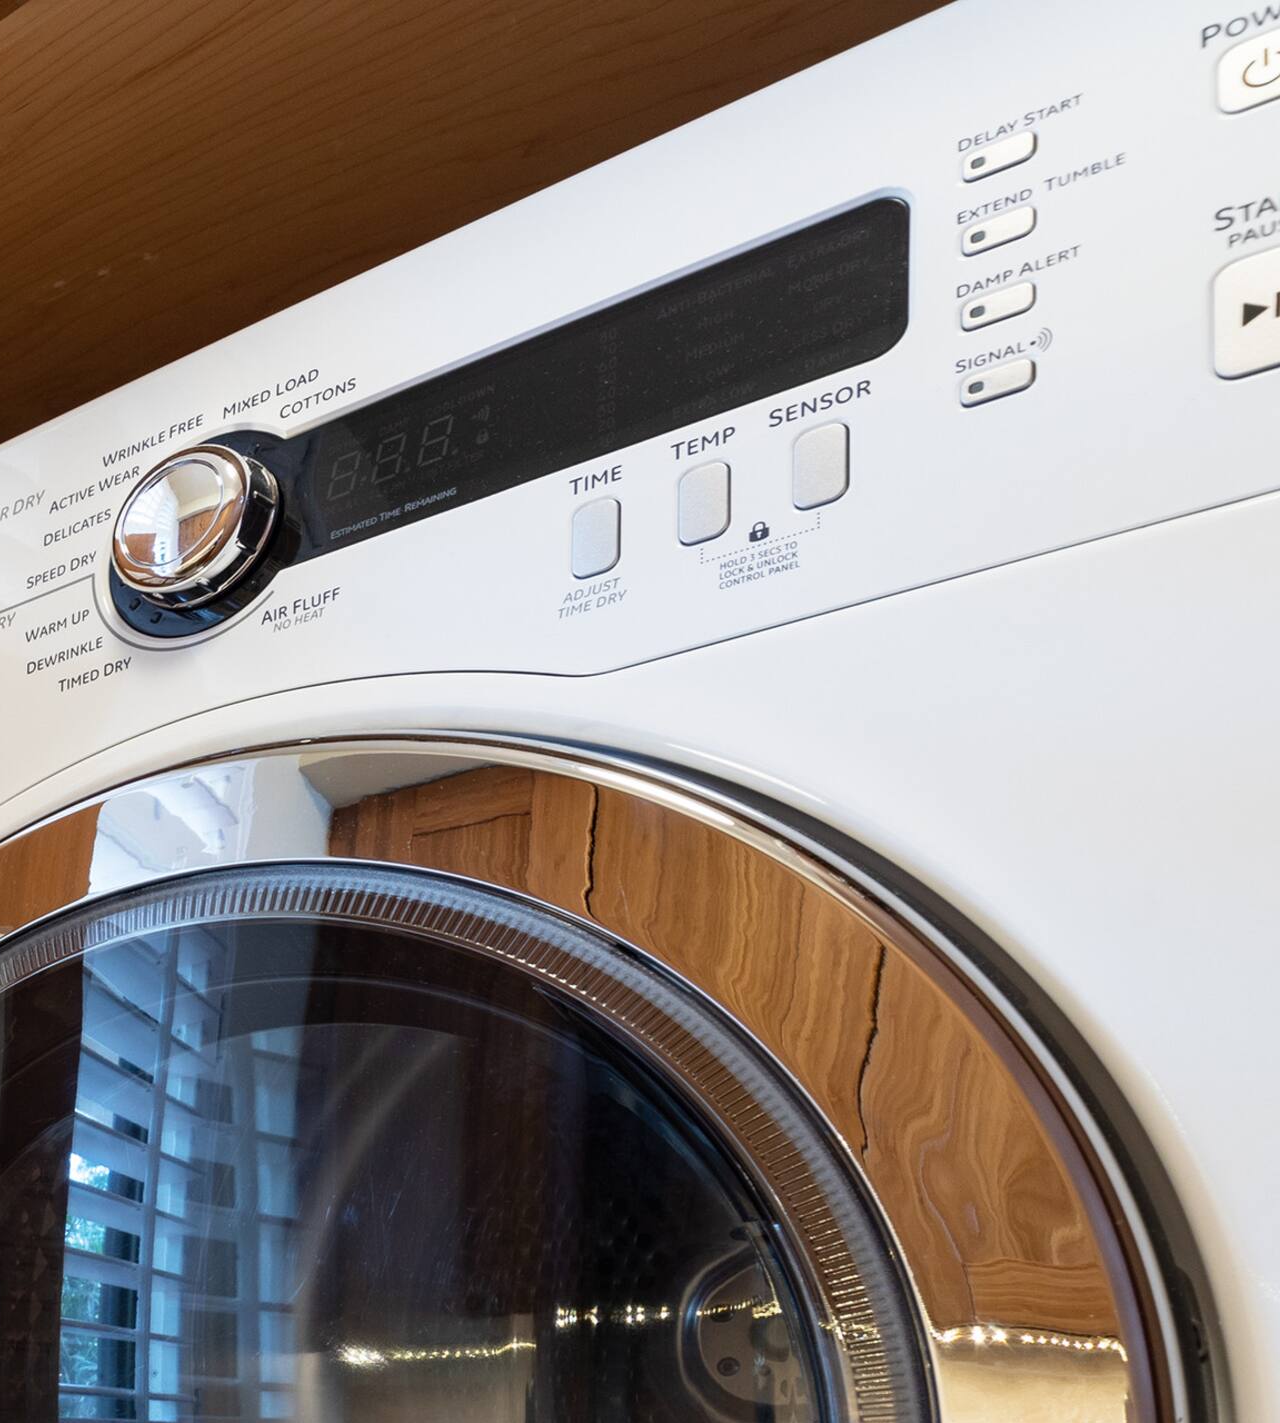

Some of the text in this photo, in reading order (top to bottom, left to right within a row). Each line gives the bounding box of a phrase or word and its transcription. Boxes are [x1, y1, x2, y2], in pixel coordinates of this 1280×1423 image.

[958, 94, 1081, 152] DELAY START
[956, 153, 1124, 225] EXTEND TUMBLE
[1228, 220, 1280, 248] PAU
[956, 245, 1080, 298] DAMP ALERT
[955, 342, 1025, 374] SIGNAL
[223, 369, 319, 419] MIXED LOAD
[279, 377, 356, 419] COTTONS
[769, 380, 871, 427] SENSOR
[103, 414, 203, 467] WRINKLE FREE
[672, 426, 735, 460] TEMP
[48, 465, 141, 514] ACTIVE WEAR
[570, 464, 622, 495] TIME
[12, 489, 45, 515] DRY
[330, 487, 457, 540] ESTIMATED TIME REMAINING
[43, 508, 111, 547] DELICATES
[26, 550, 96, 589] SPEED DRY
[719, 540, 798, 570] HOLD 3 SECS TO
[719, 551, 798, 580] LOCK & UNLOCK
[562, 577, 621, 604] ADJUST
[719, 560, 800, 589] CONTROL PANEL
[261, 587, 340, 625] AIR FLUFF
[273, 609, 323, 632] NO HEAT
[559, 589, 627, 619] TIME DRY
[25, 609, 89, 642] WARM UP
[26, 636, 103, 675] DEWRINKLE
[59, 656, 132, 692] TIMED DRY
